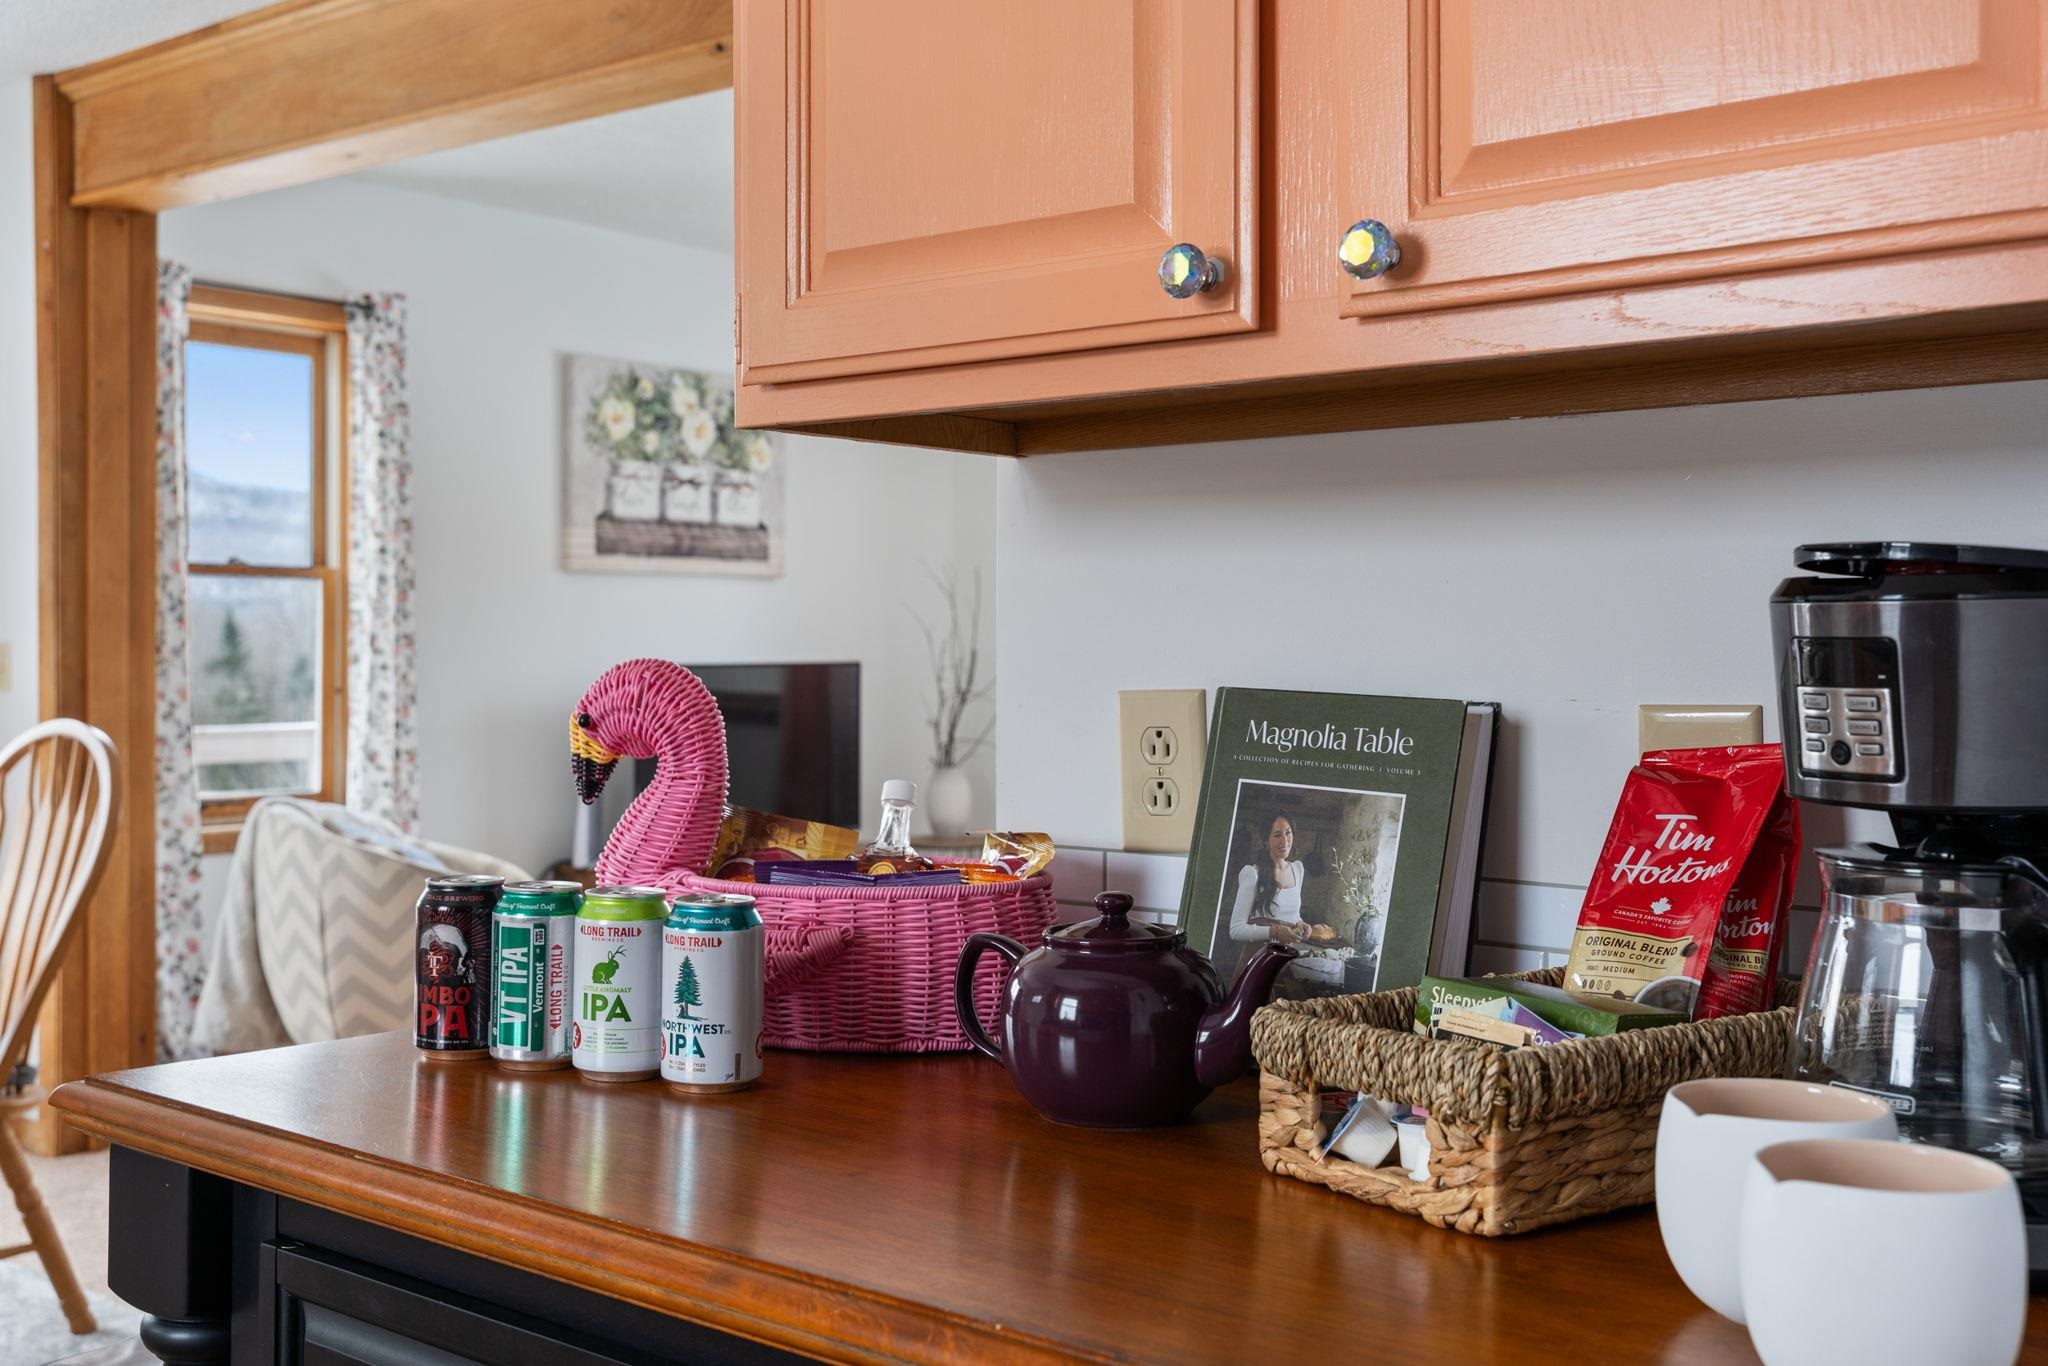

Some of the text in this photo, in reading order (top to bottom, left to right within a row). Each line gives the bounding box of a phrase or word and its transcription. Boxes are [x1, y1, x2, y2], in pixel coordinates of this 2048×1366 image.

[1245, 719, 1414, 756] Magnolia Table
[1239, 754, 1279, 764] COLLECTION
[1291, 759, 1319, 767] RECIPES
[1336, 762, 1375, 772] GATHERING
[1654, 813, 1716, 851] Tim
[1611, 845, 1733, 885] Hortons
[1614, 909, 1643, 919] CANADA'S
[1643, 914, 1672, 925] FAVORITE
[583, 925, 636, 938] LONG TRAIL
[667, 933, 717, 948] LONG TRAIL
[1585, 935, 1678, 957] ORIGINAL BLEND
[1591, 949, 1667, 965] GROUND COFFEE
[1602, 965, 1636, 975] MEDIUM
[500, 947, 529, 1024] VT IPA
[532, 961, 545, 1014] Vermont
[550, 948, 563, 1025] LONG TRAIL
[583, 992, 632, 1023] IPA
[663, 1019, 725, 1035] NORTHWEST
[669, 1032, 706, 1059] IPA
